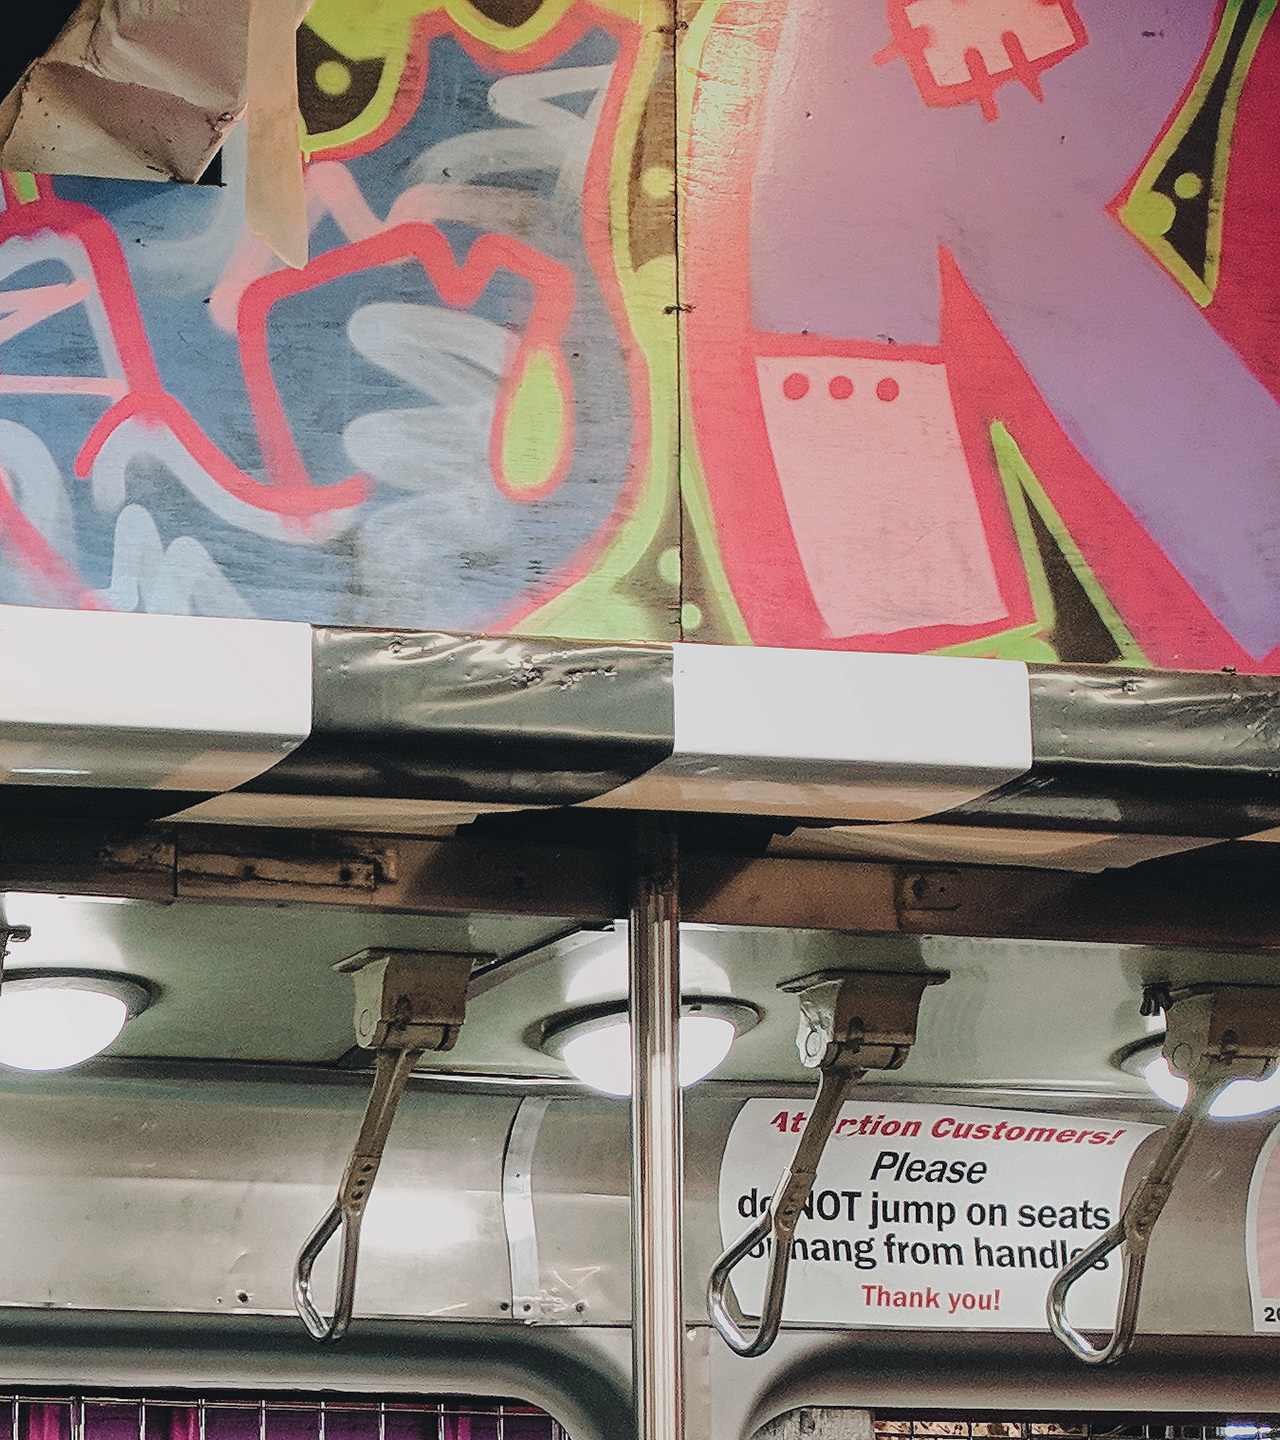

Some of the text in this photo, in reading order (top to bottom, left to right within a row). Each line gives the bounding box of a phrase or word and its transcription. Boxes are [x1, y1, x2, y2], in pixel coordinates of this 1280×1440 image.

[930, 1116, 1127, 1146] Customers!
[869, 1150, 988, 1185] Please
[868, 1190, 956, 1232] jump
[966, 1201, 1008, 1227] on
[1016, 1199, 1112, 1231] seats
[883, 1232, 964, 1266] from
[861, 1284, 1002, 1314] Thank you!
